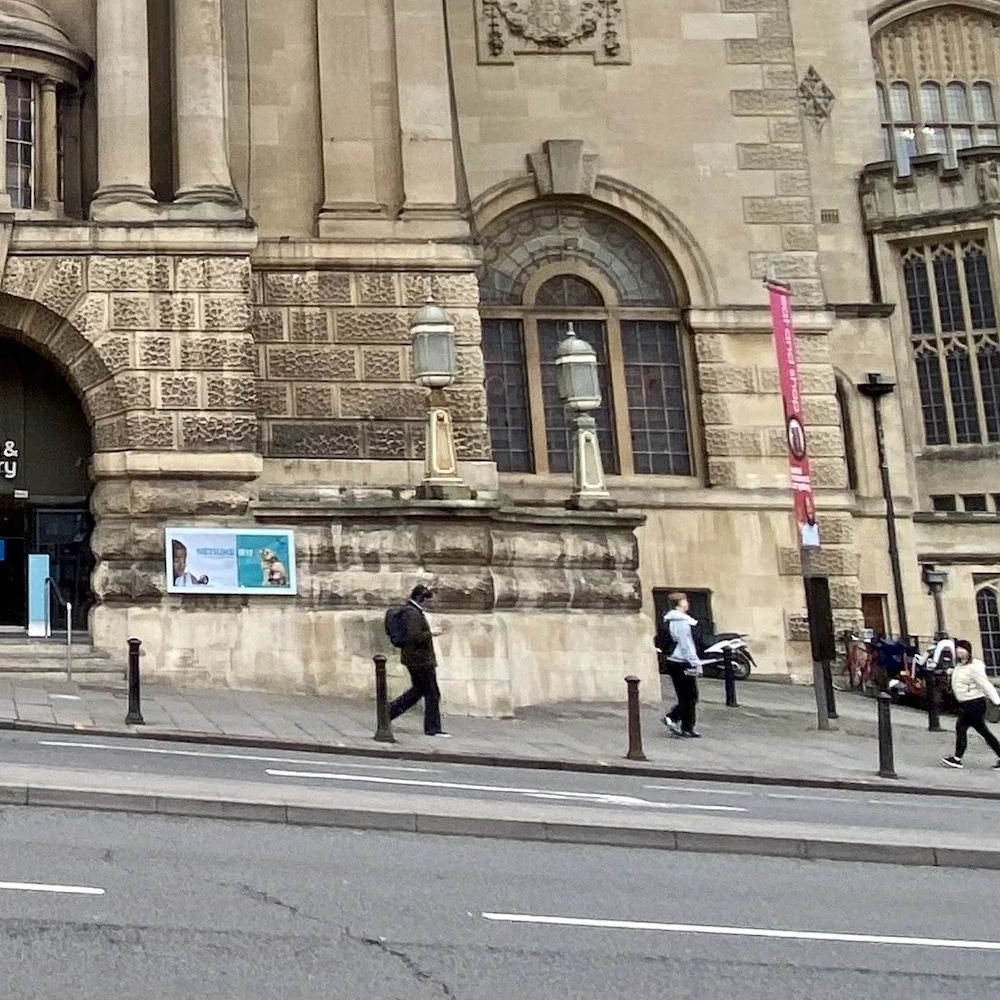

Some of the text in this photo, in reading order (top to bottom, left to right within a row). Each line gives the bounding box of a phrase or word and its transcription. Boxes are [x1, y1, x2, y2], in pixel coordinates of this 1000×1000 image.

[784, 328, 795, 365] and
[789, 369, 800, 412] shop
[3, 440, 18, 457] &
